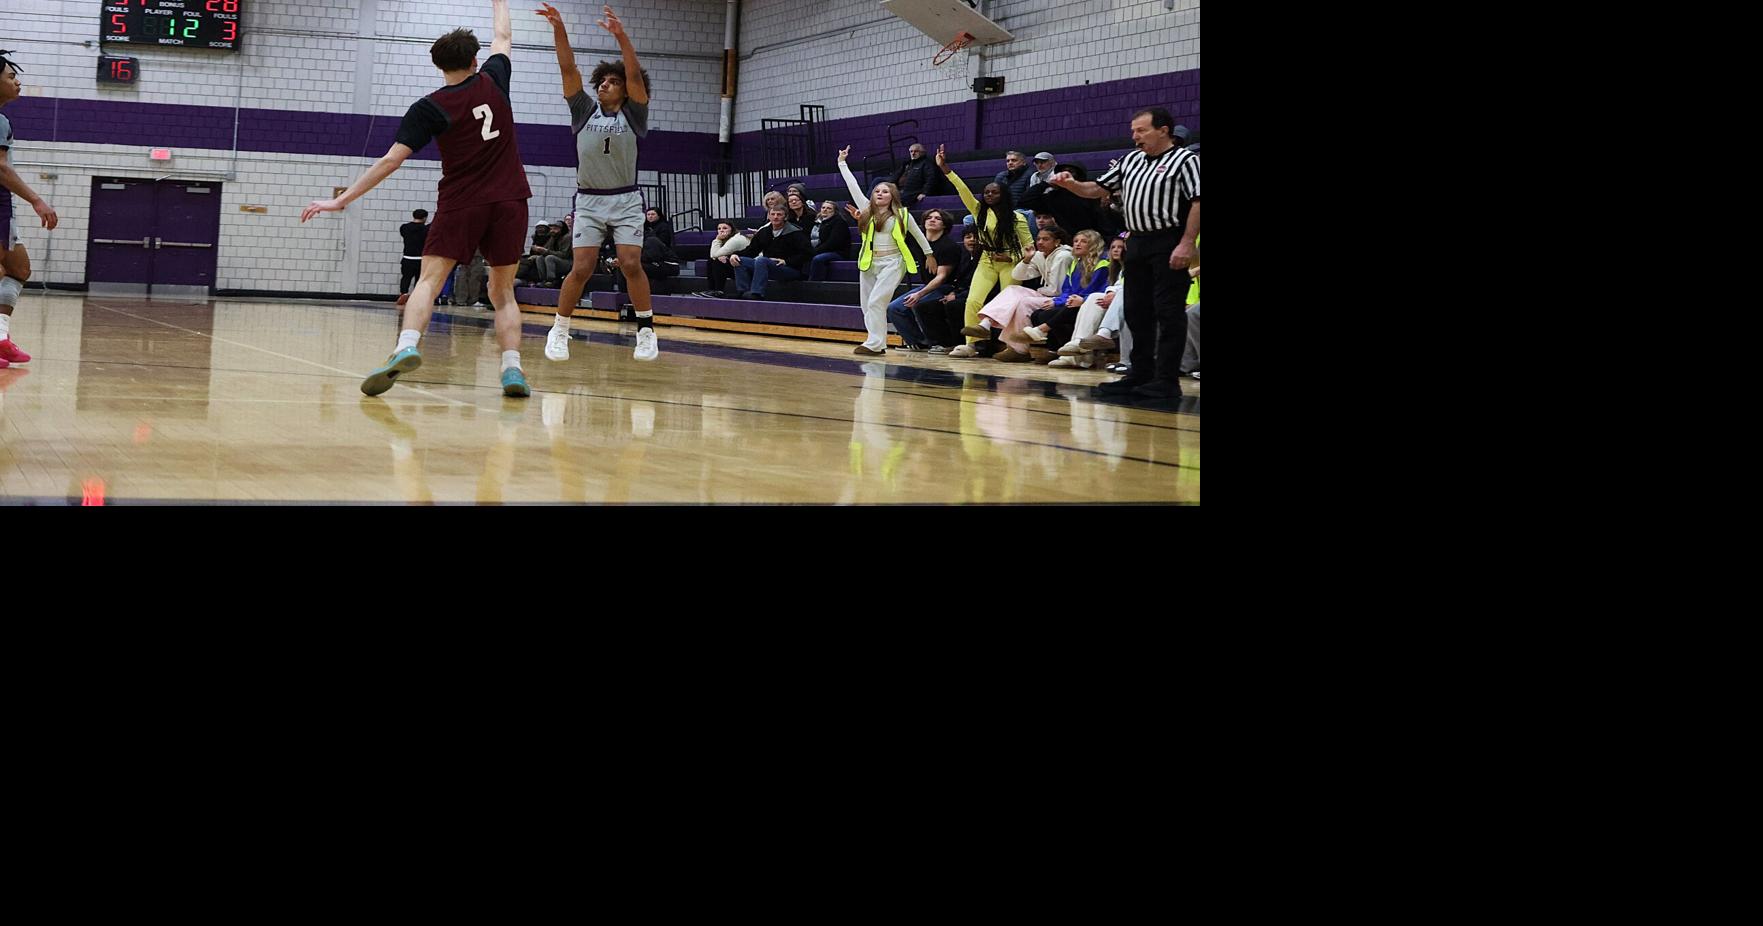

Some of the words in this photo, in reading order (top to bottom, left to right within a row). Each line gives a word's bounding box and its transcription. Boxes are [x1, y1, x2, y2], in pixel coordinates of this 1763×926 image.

[112, 14, 126, 33] 5
[223, 21, 236, 40] 3
[111, 61, 131, 80] 16
[472, 103, 500, 141] 2
[603, 136, 611, 155] 1
